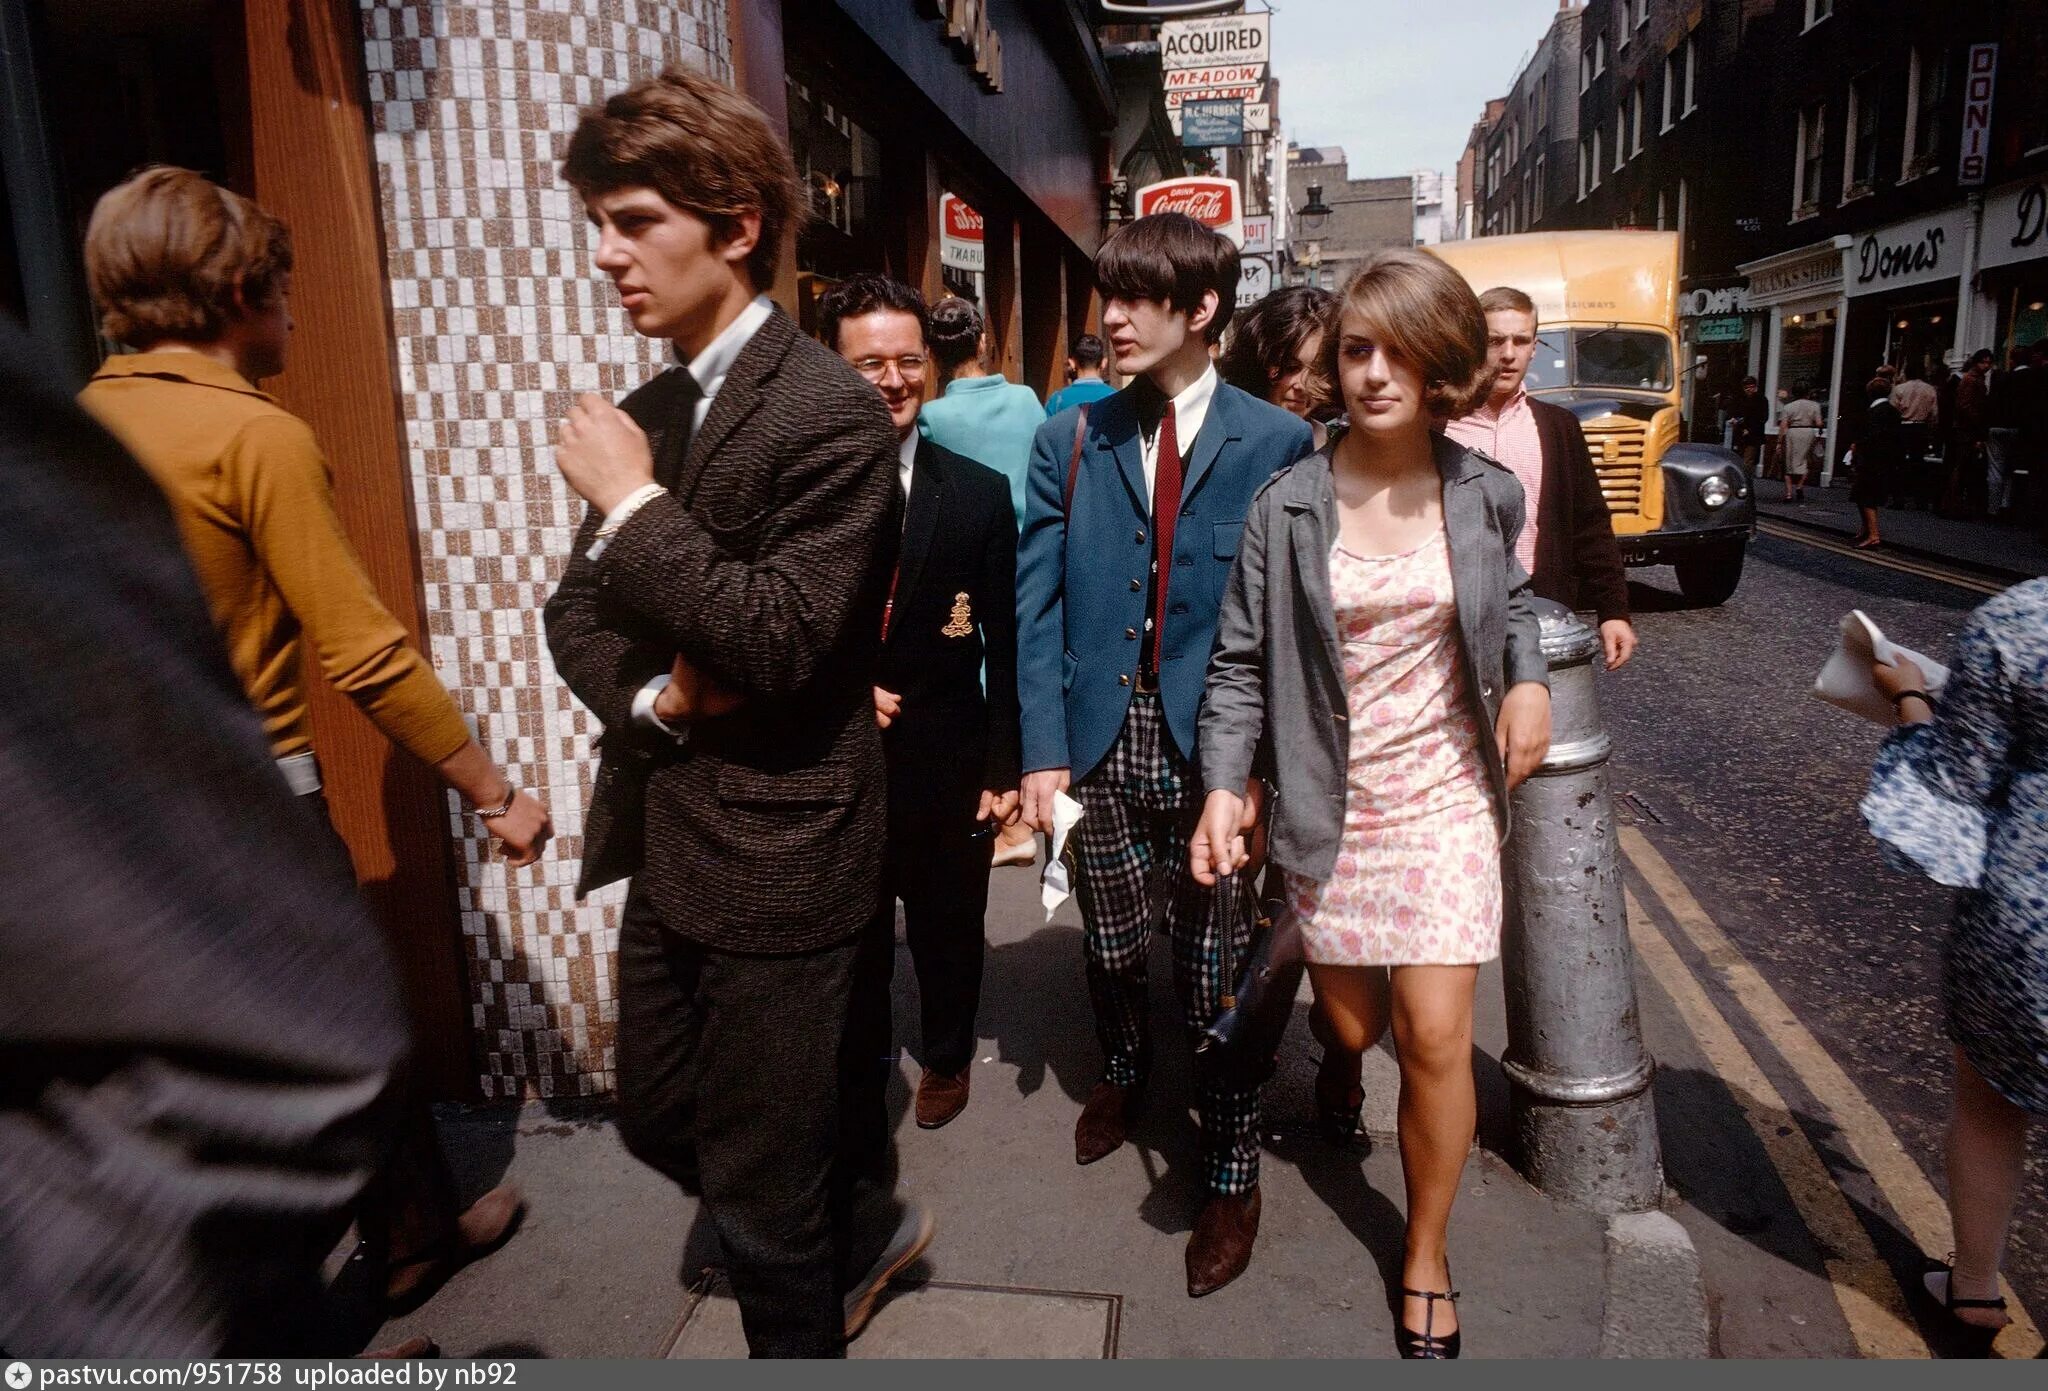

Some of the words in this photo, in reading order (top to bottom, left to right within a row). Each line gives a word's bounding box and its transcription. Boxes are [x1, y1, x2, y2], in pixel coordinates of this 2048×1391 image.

[1165, 28, 1262, 56] ACQUIRED
[1168, 67, 1257, 86] MEADOW
[1962, 48, 1993, 180] DONIS
[1170, 187, 1196, 197] DRINK
